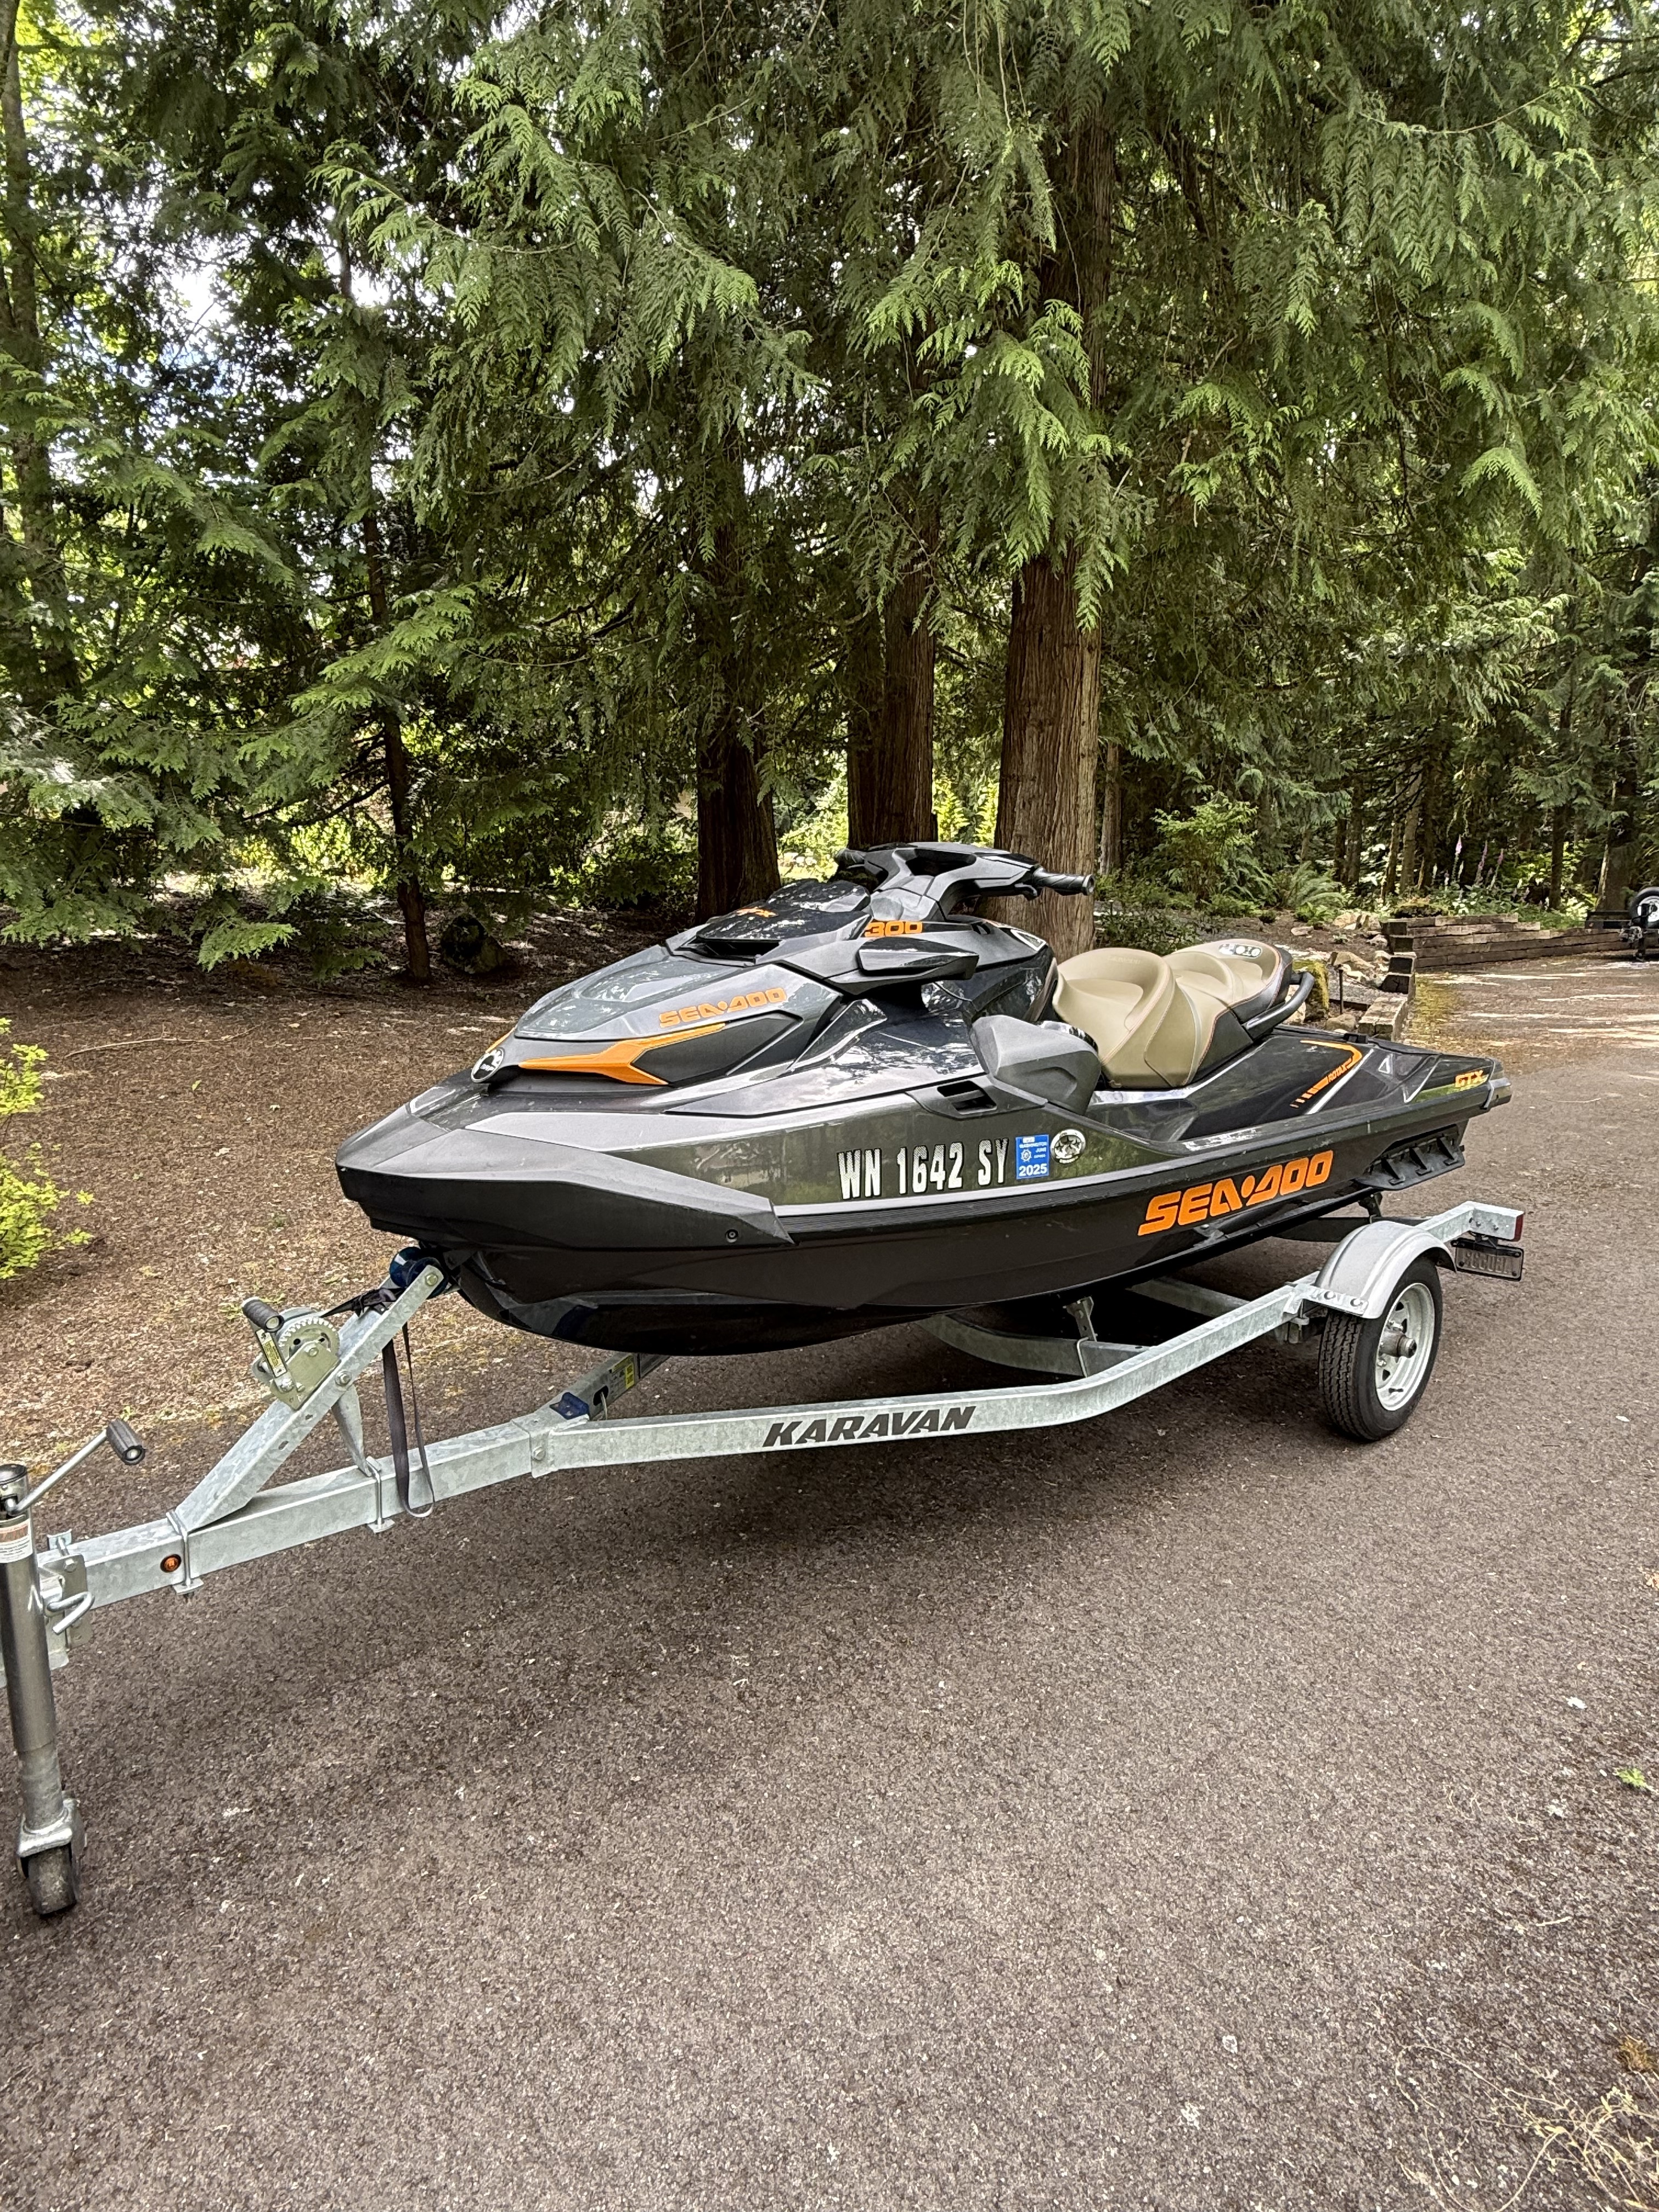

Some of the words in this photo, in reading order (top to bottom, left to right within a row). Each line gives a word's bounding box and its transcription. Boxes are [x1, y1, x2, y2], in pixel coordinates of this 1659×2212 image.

[865, 921, 923, 937] 300
[1328, 1064, 1347, 1082] ROTAX
[1455, 1070, 1483, 1087] GTX
[837, 1147, 882, 1199] WN
[896, 1141, 964, 1195] 1642
[977, 1137, 1009, 1186] SY
[1019, 1163, 1047, 1177] 2025
[763, 1406, 977, 1447] KARAVAN
